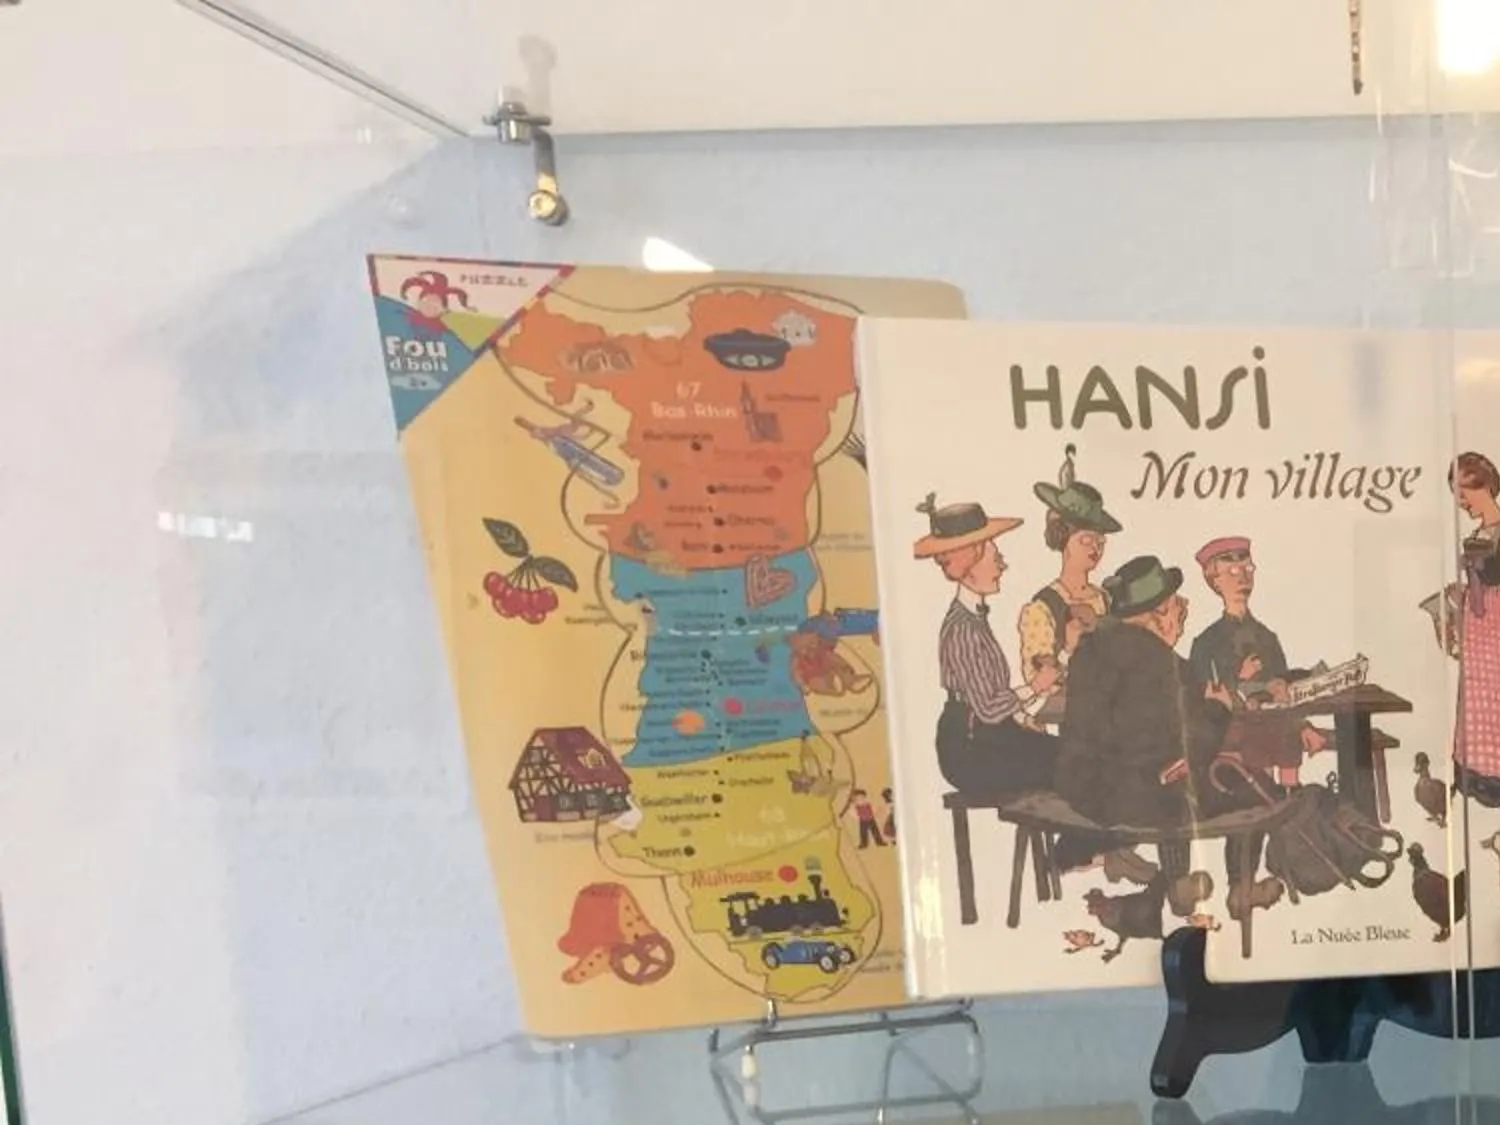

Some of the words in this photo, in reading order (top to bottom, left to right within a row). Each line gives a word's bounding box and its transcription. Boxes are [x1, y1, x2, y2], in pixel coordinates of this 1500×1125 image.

[1131, 451, 1249, 500] Mon
[1265, 452, 1422, 513] village
[691, 869, 775, 888] Mulhouse
[1290, 929, 1313, 945] La
[1365, 925, 1411, 941] Bleue
